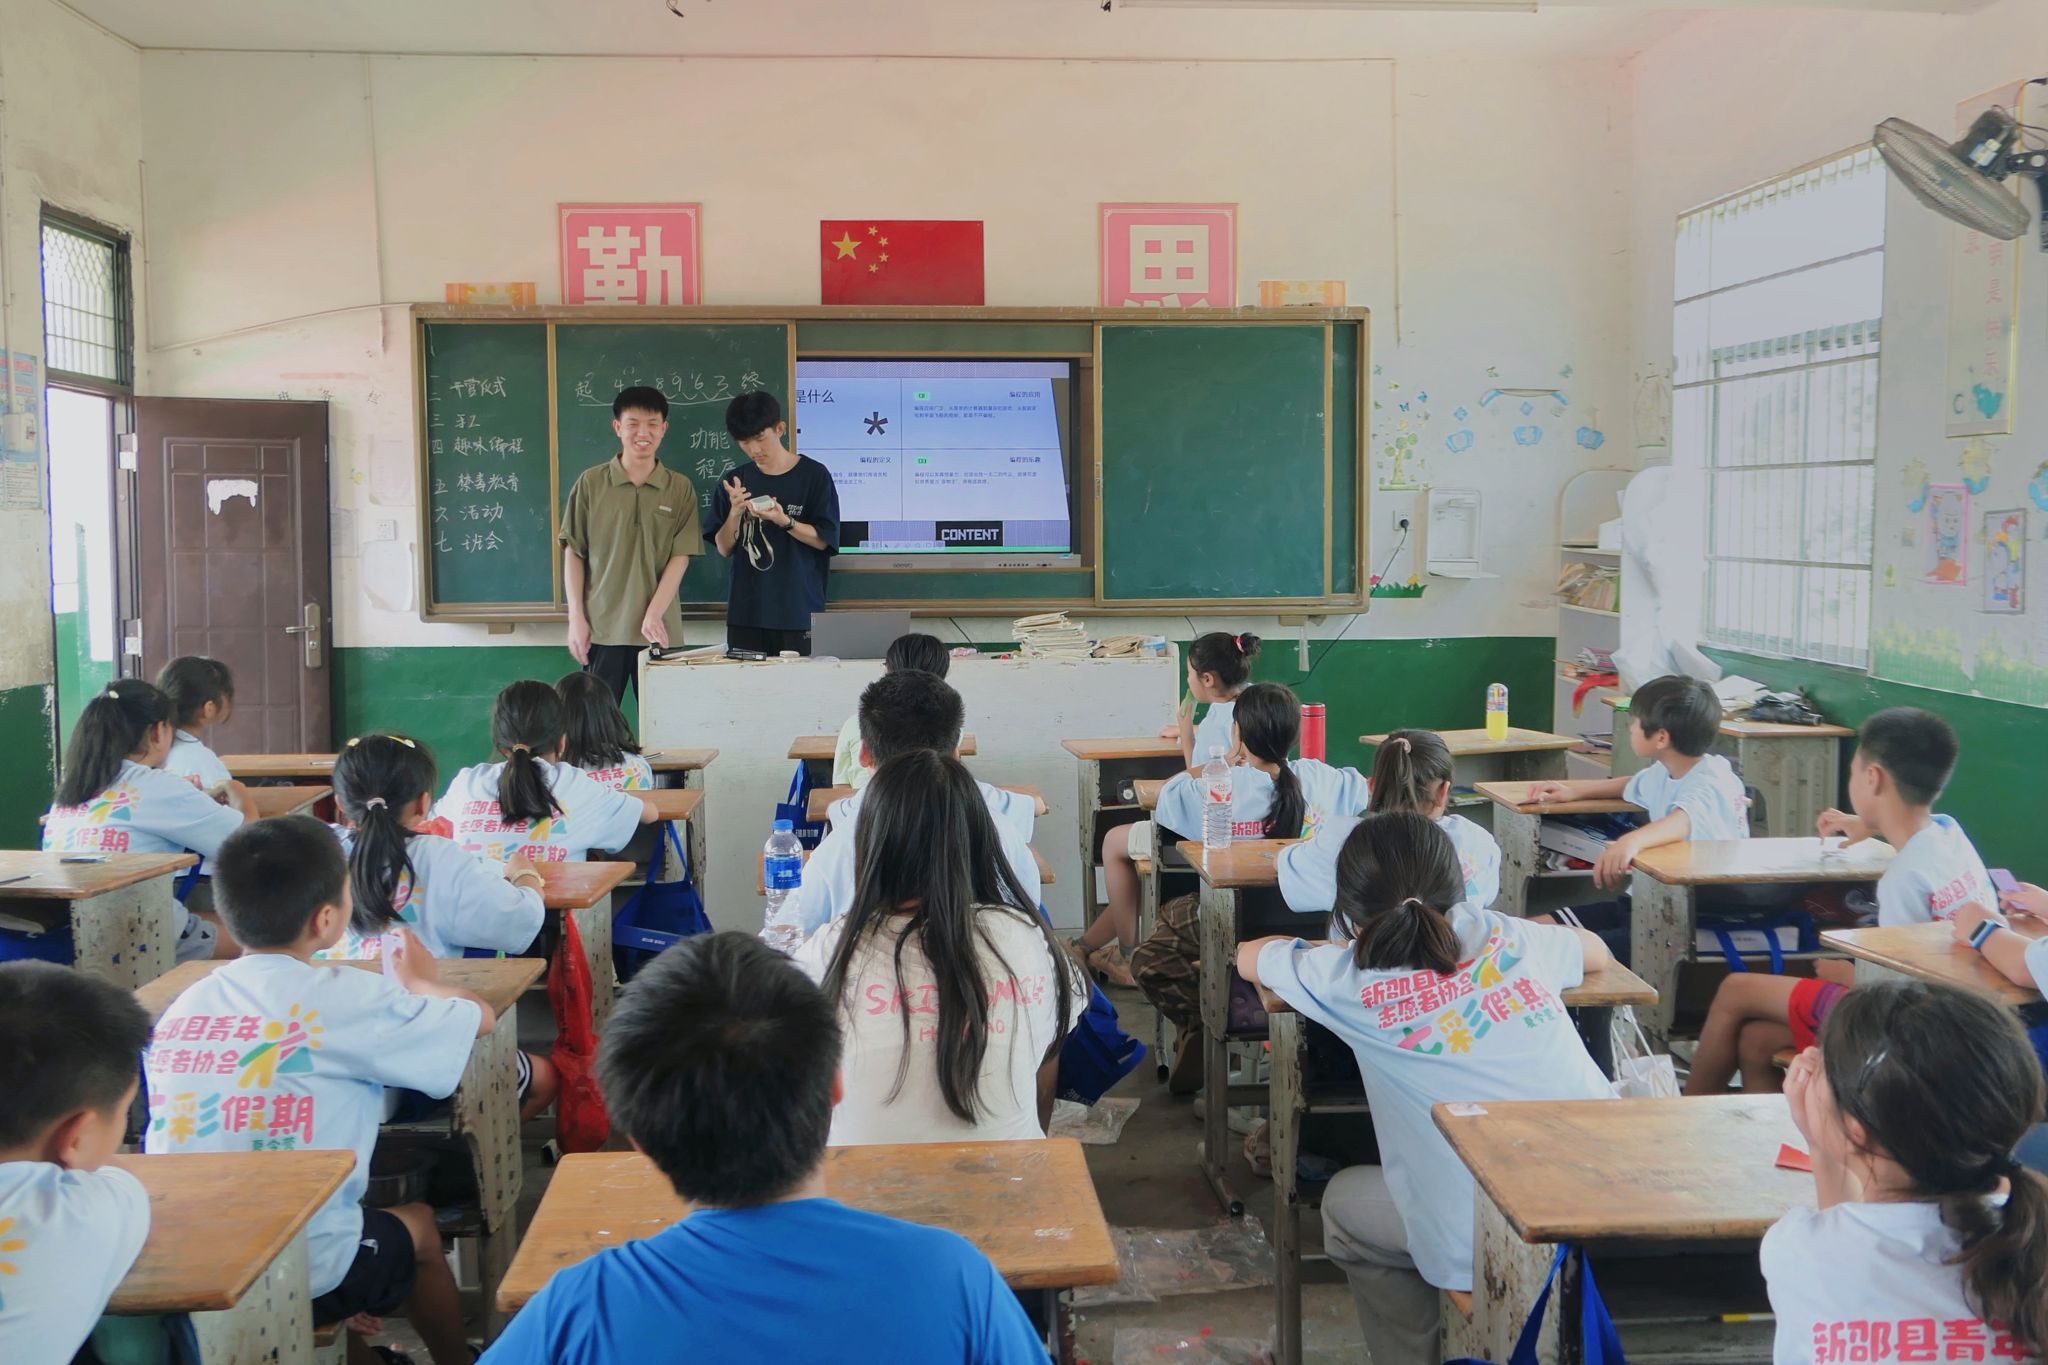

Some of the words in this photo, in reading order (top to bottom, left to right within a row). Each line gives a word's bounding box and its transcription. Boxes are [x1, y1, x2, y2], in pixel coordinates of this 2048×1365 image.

[577, 226, 683, 304] 勤
[432, 439, 444, 454] 四
[690, 428, 730, 449] 功能
[459, 502, 503, 523] 活动
[434, 530, 453, 553] 七
[941, 529, 999, 541] CONTENT
[1378, 971, 1475, 1029] 志愿者协会
[1397, 976, 1564, 1056] 七彩假期
[1812, 1318, 2026, 1364] 新邵县青年
